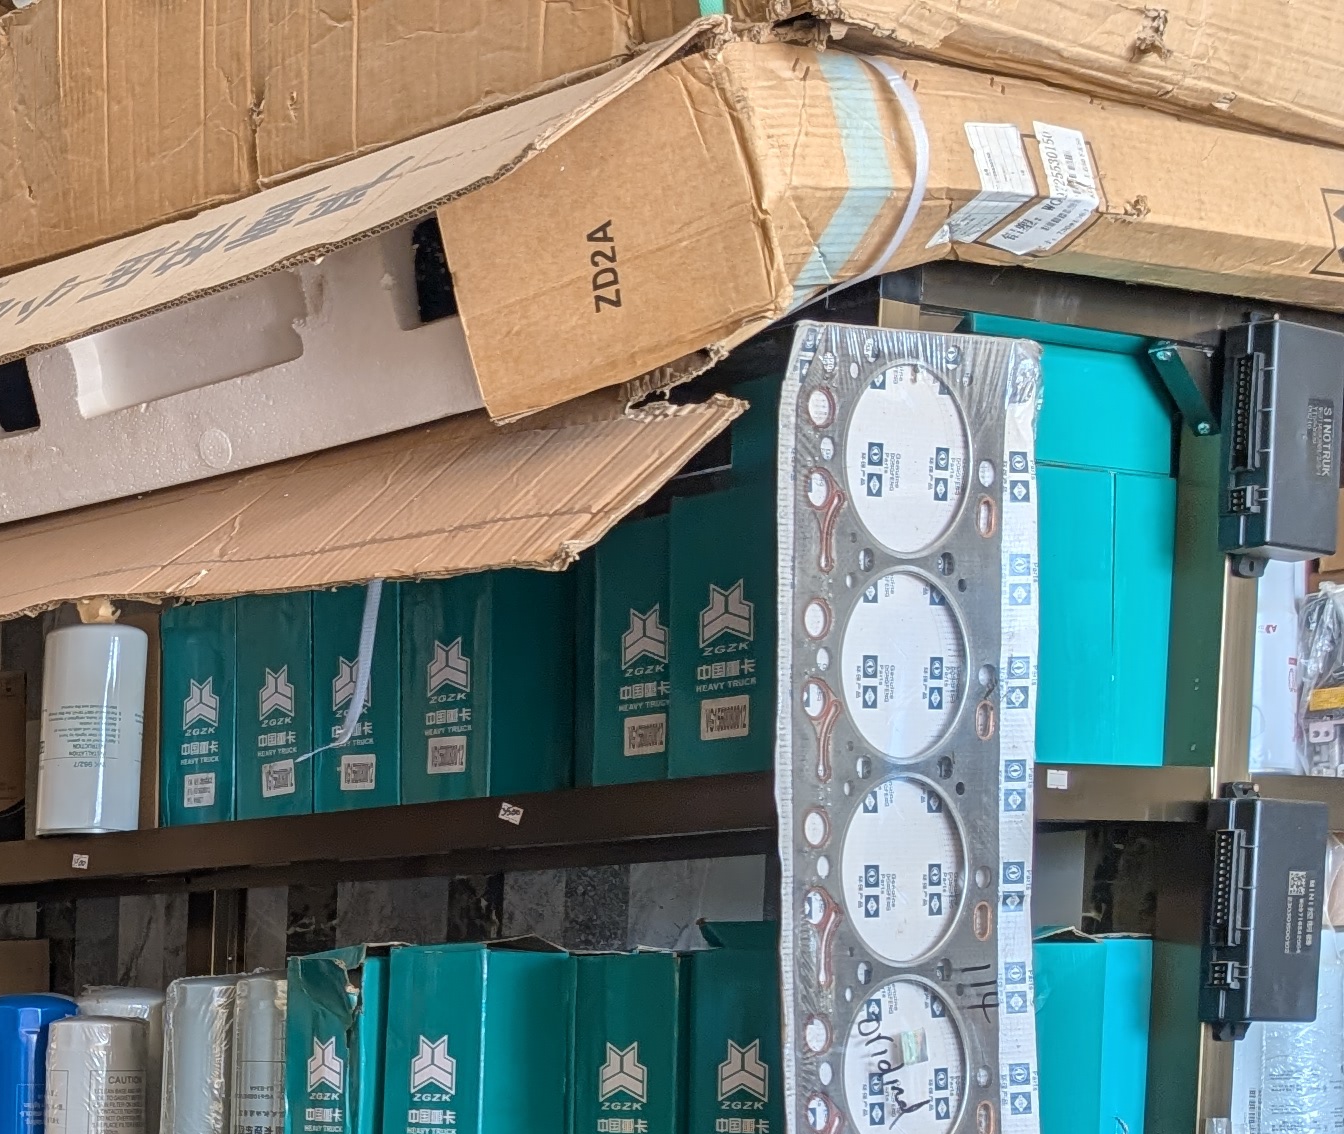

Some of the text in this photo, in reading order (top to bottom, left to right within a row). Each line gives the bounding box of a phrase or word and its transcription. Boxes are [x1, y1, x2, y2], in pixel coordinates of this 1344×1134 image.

[586, 219, 622, 313] ZD2A
[1321, 407, 1333, 476] SINOTRUK
[703, 642, 749, 656] ZGZK
[624, 664, 664, 677] ZGZK
[428, 693, 466, 704] ZGZK
[261, 716, 292, 727] ZGZK
[185, 726, 215, 736] ZGZK
[1307, 880, 1315, 905] MINI
[412, 1094, 451, 1102] ZGZK
[601, 1102, 643, 1110] ZGZK
[721, 1101, 764, 1110] ZGZK
